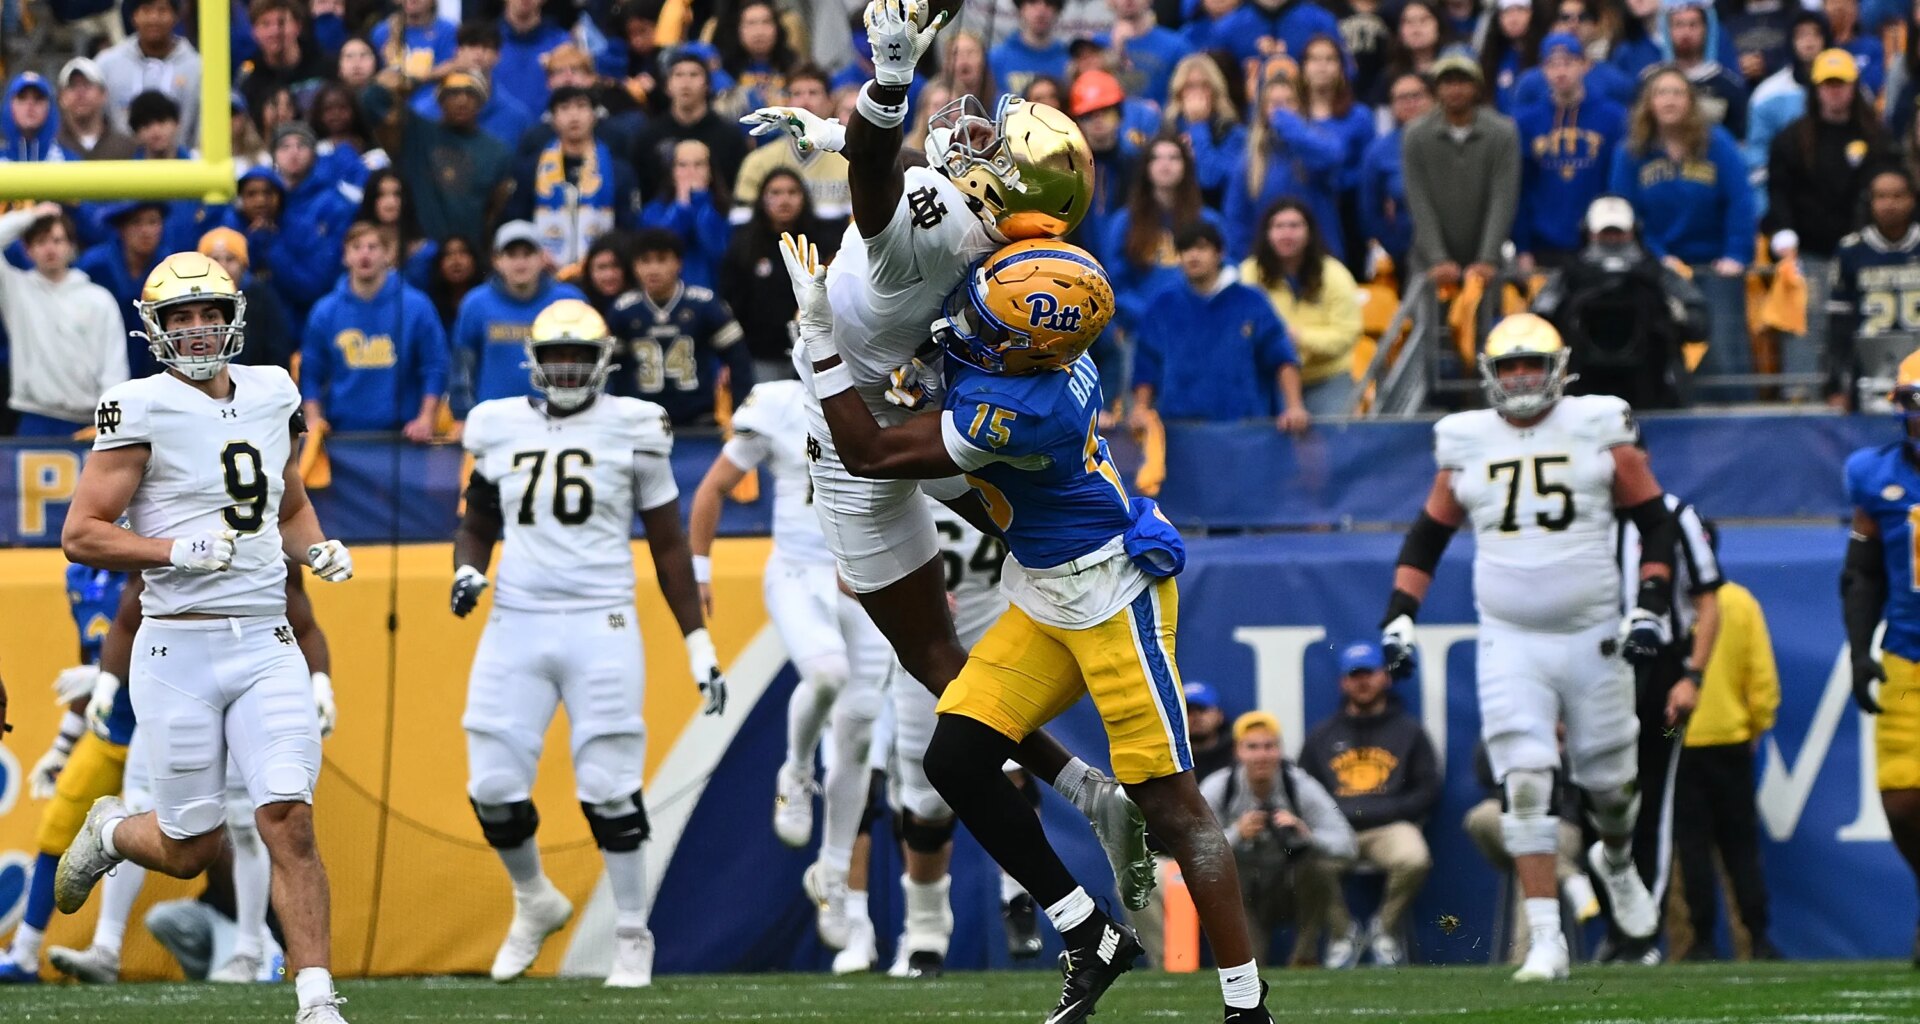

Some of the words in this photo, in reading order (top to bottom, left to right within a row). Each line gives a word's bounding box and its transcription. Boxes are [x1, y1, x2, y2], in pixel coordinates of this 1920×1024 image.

[1025, 292, 1082, 333] Pitt
[334, 328, 397, 369] Pitt
[632, 335, 699, 393] 34
[1068, 350, 1098, 409] BAT
[967, 403, 1017, 448] 15
[17, 449, 90, 536] P
[221, 440, 268, 534] 9
[511, 448, 594, 526] 76
[1487, 453, 1575, 536] 75
[1096, 923, 1121, 966] NIKE
